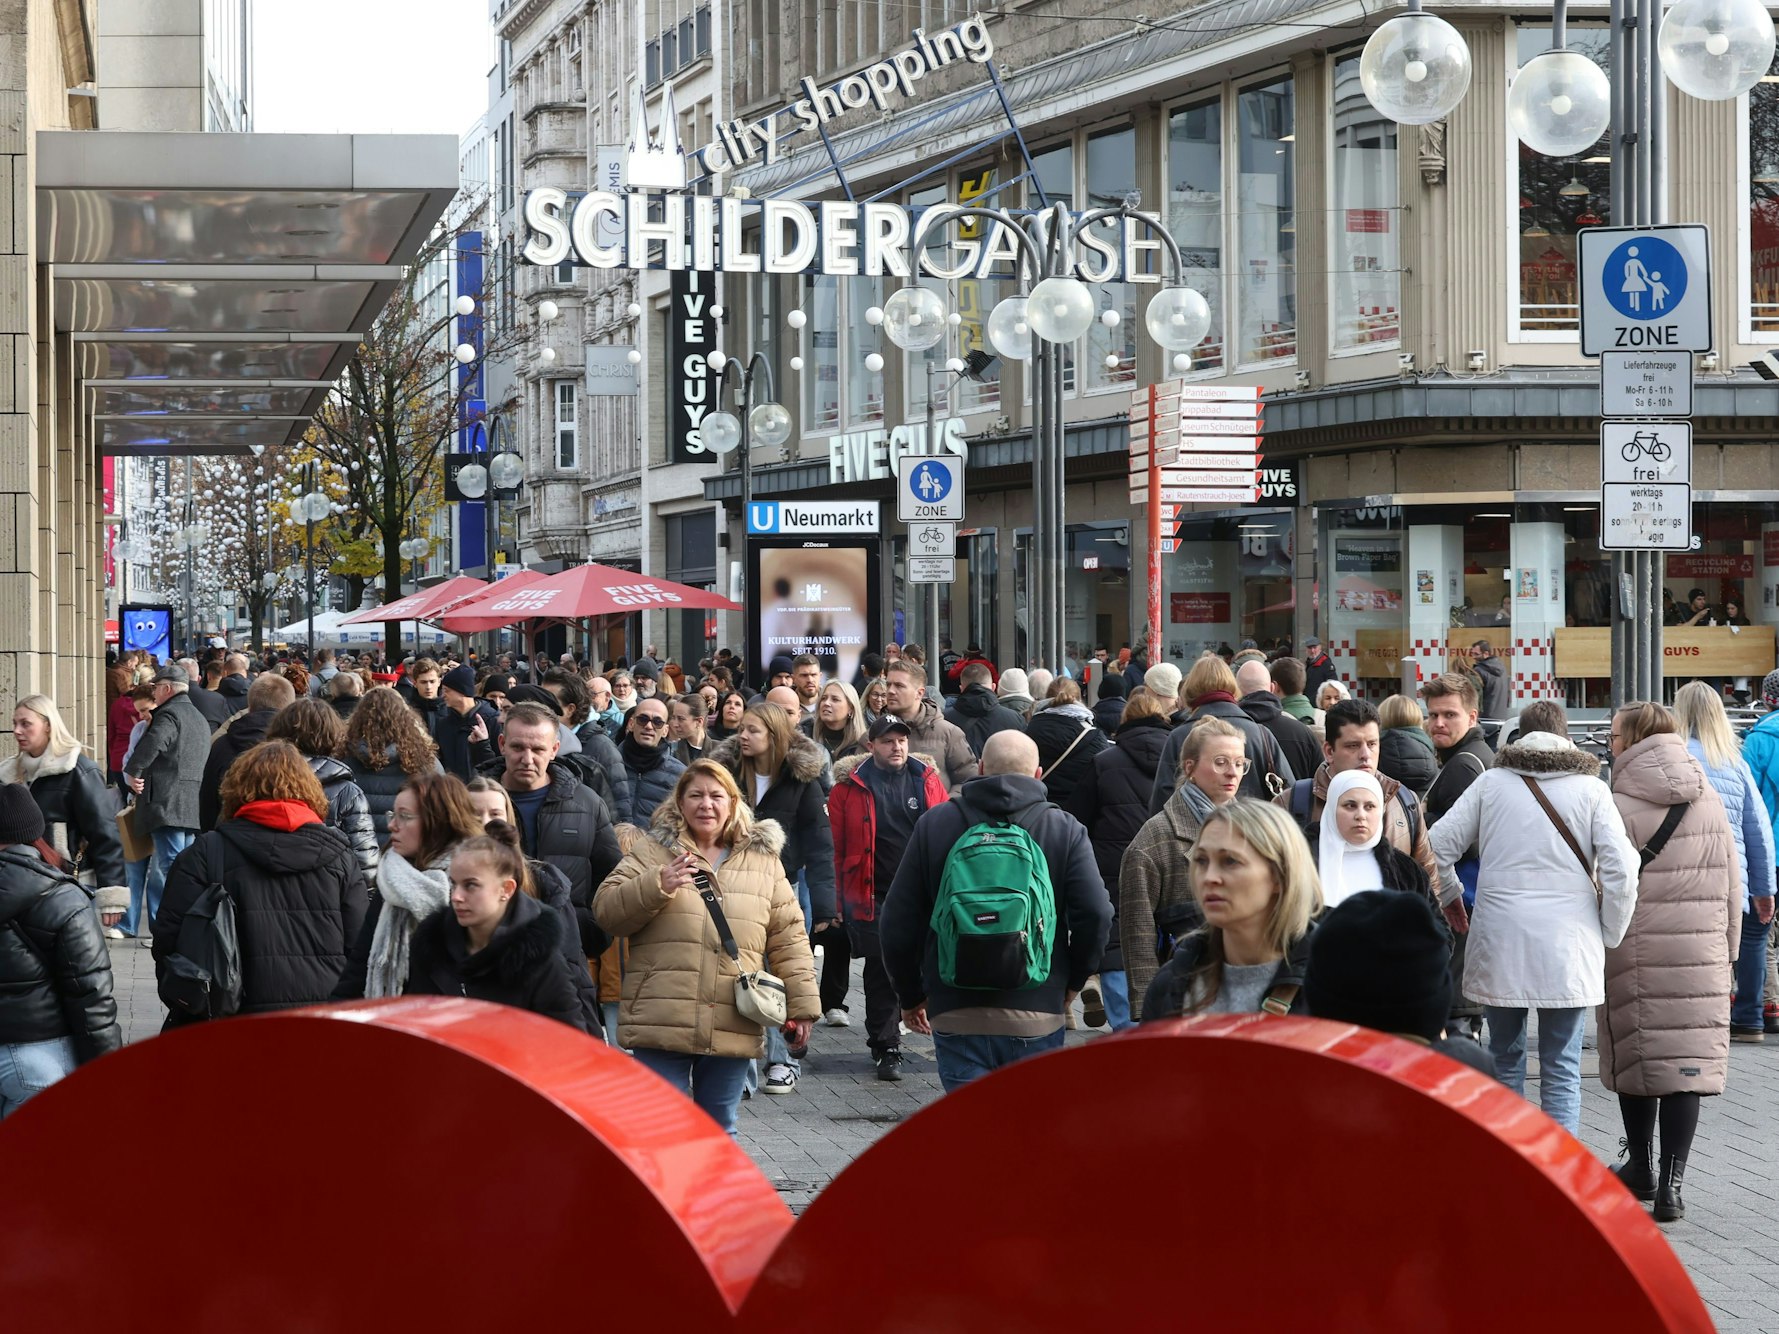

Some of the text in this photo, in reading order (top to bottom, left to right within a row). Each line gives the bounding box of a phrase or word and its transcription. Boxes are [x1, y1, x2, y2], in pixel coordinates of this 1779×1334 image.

[699, 13, 995, 175] city shopping
[1615, 325, 1679, 347] ZONE
[589, 363, 633, 377] CHRIST
[1623, 361, 1677, 373] Lieferfahrzeuge
[1643, 372, 1655, 382] frei
[1185, 388, 1227, 397] Pantaleon
[1625, 386, 1646, 395] Mo-Fr
[1648, 386, 1653, 395] 6
[1658, 386, 1666, 395] 11
[1668, 386, 1673, 395] h
[683, 354, 707, 454] GUYS
[1635, 398, 1644, 407] Sa
[1647, 398, 1652, 407] 6
[1656, 398, 1666, 407] 10
[1667, 398, 1672, 407] h
[1181, 406, 1222, 416] grippabad
[1210, 423, 1255, 433] Schnütgen
[1181, 439, 1194, 447] HS
[829, 429, 889, 484] FIVE
[1176, 474, 1245, 482] Gesundheitsamt
[1253, 469, 1291, 483] IVE
[1633, 466, 1660, 481] frei
[1176, 491, 1245, 500] Rautenstrauch-Joest
[1249, 483, 1296, 498] UYS
[1630, 488, 1663, 499] werktags
[915, 506, 947, 516] ZONE
[1632, 502, 1642, 511] 20
[1658, 502, 1663, 511] h
[752, 505, 874, 531] U Neumarkt
[925, 545, 940, 553] frei
[1337, 553, 1360, 561] Brown
[1361, 553, 1381, 562] Paper
[1685, 558, 1736, 566] RECYCLING
[1692, 566, 1730, 574] STATION
[511, 589, 563, 599] FIVE
[602, 584, 664, 596] FIVE
[612, 592, 682, 605] GUYS
[490, 600, 550, 610] GUYS
[768, 636, 861, 645] KULTURHANDWERK
[792, 647, 837, 655] SEIT 1910.
[1489, 648, 1511, 656] UYS
[1664, 646, 1700, 656] GUYS
